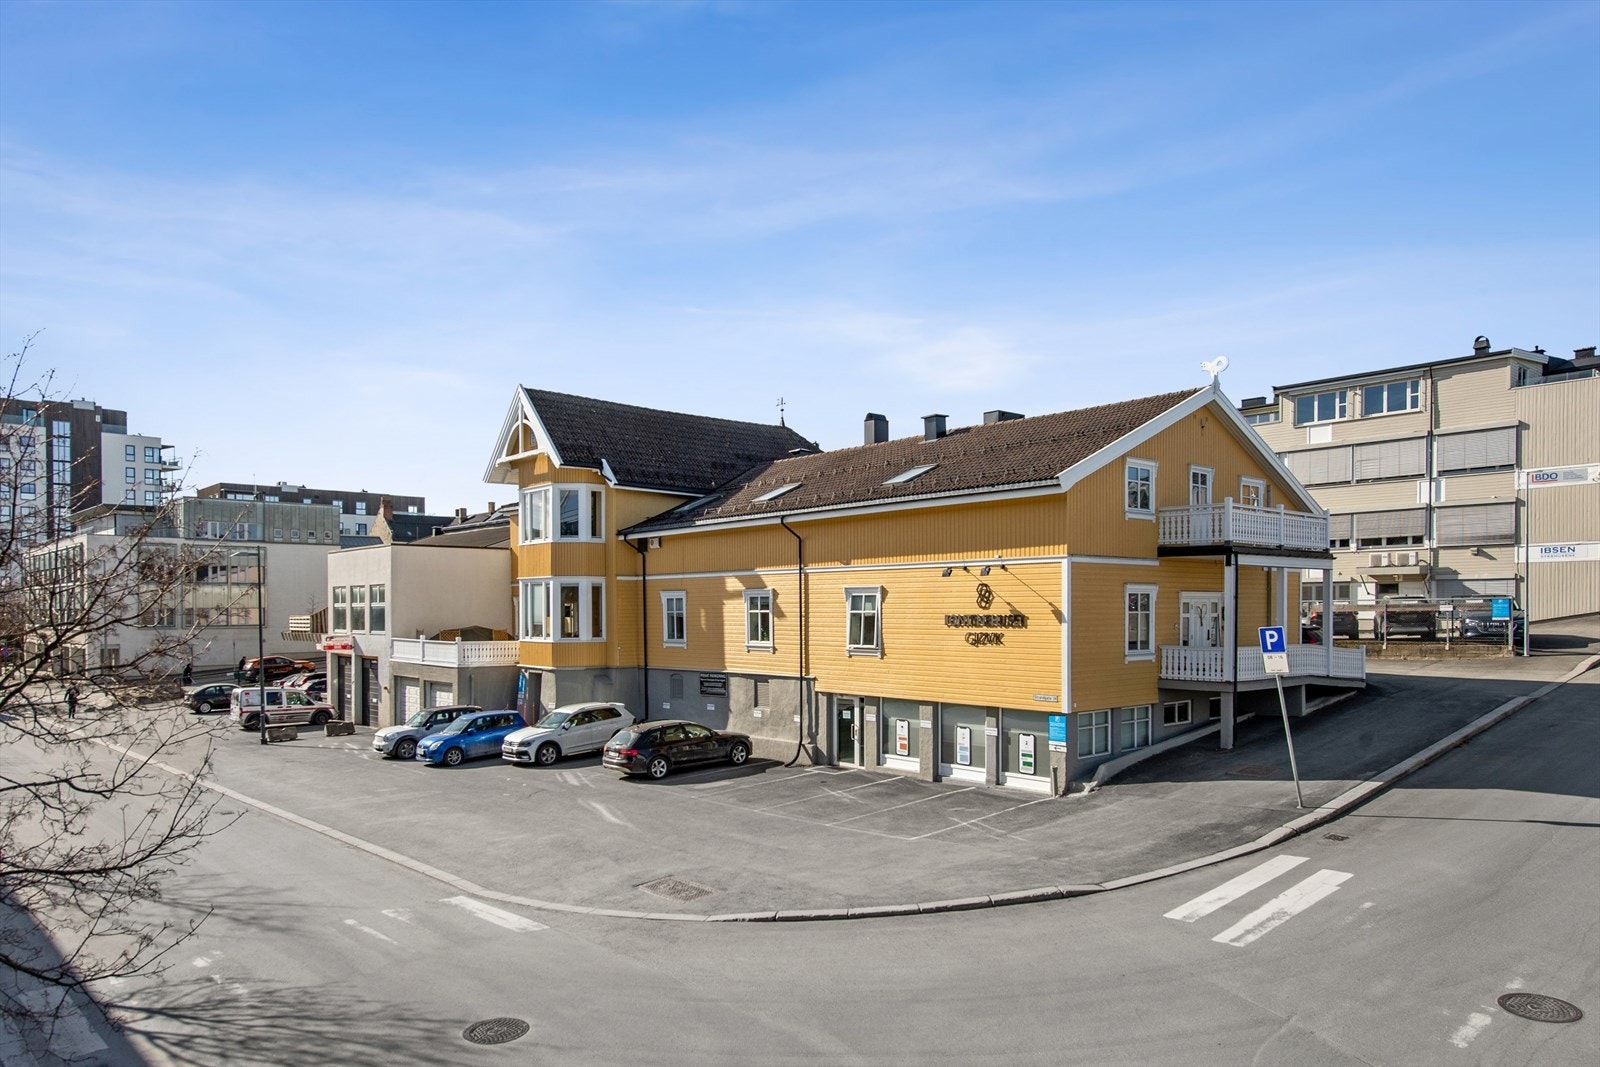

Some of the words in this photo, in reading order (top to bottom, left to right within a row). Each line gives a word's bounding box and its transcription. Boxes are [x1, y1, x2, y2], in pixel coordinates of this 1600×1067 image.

[1535, 472, 1558, 481] BDO
[1540, 546, 1576, 554] IBSEN
[1265, 630, 1279, 650] P
